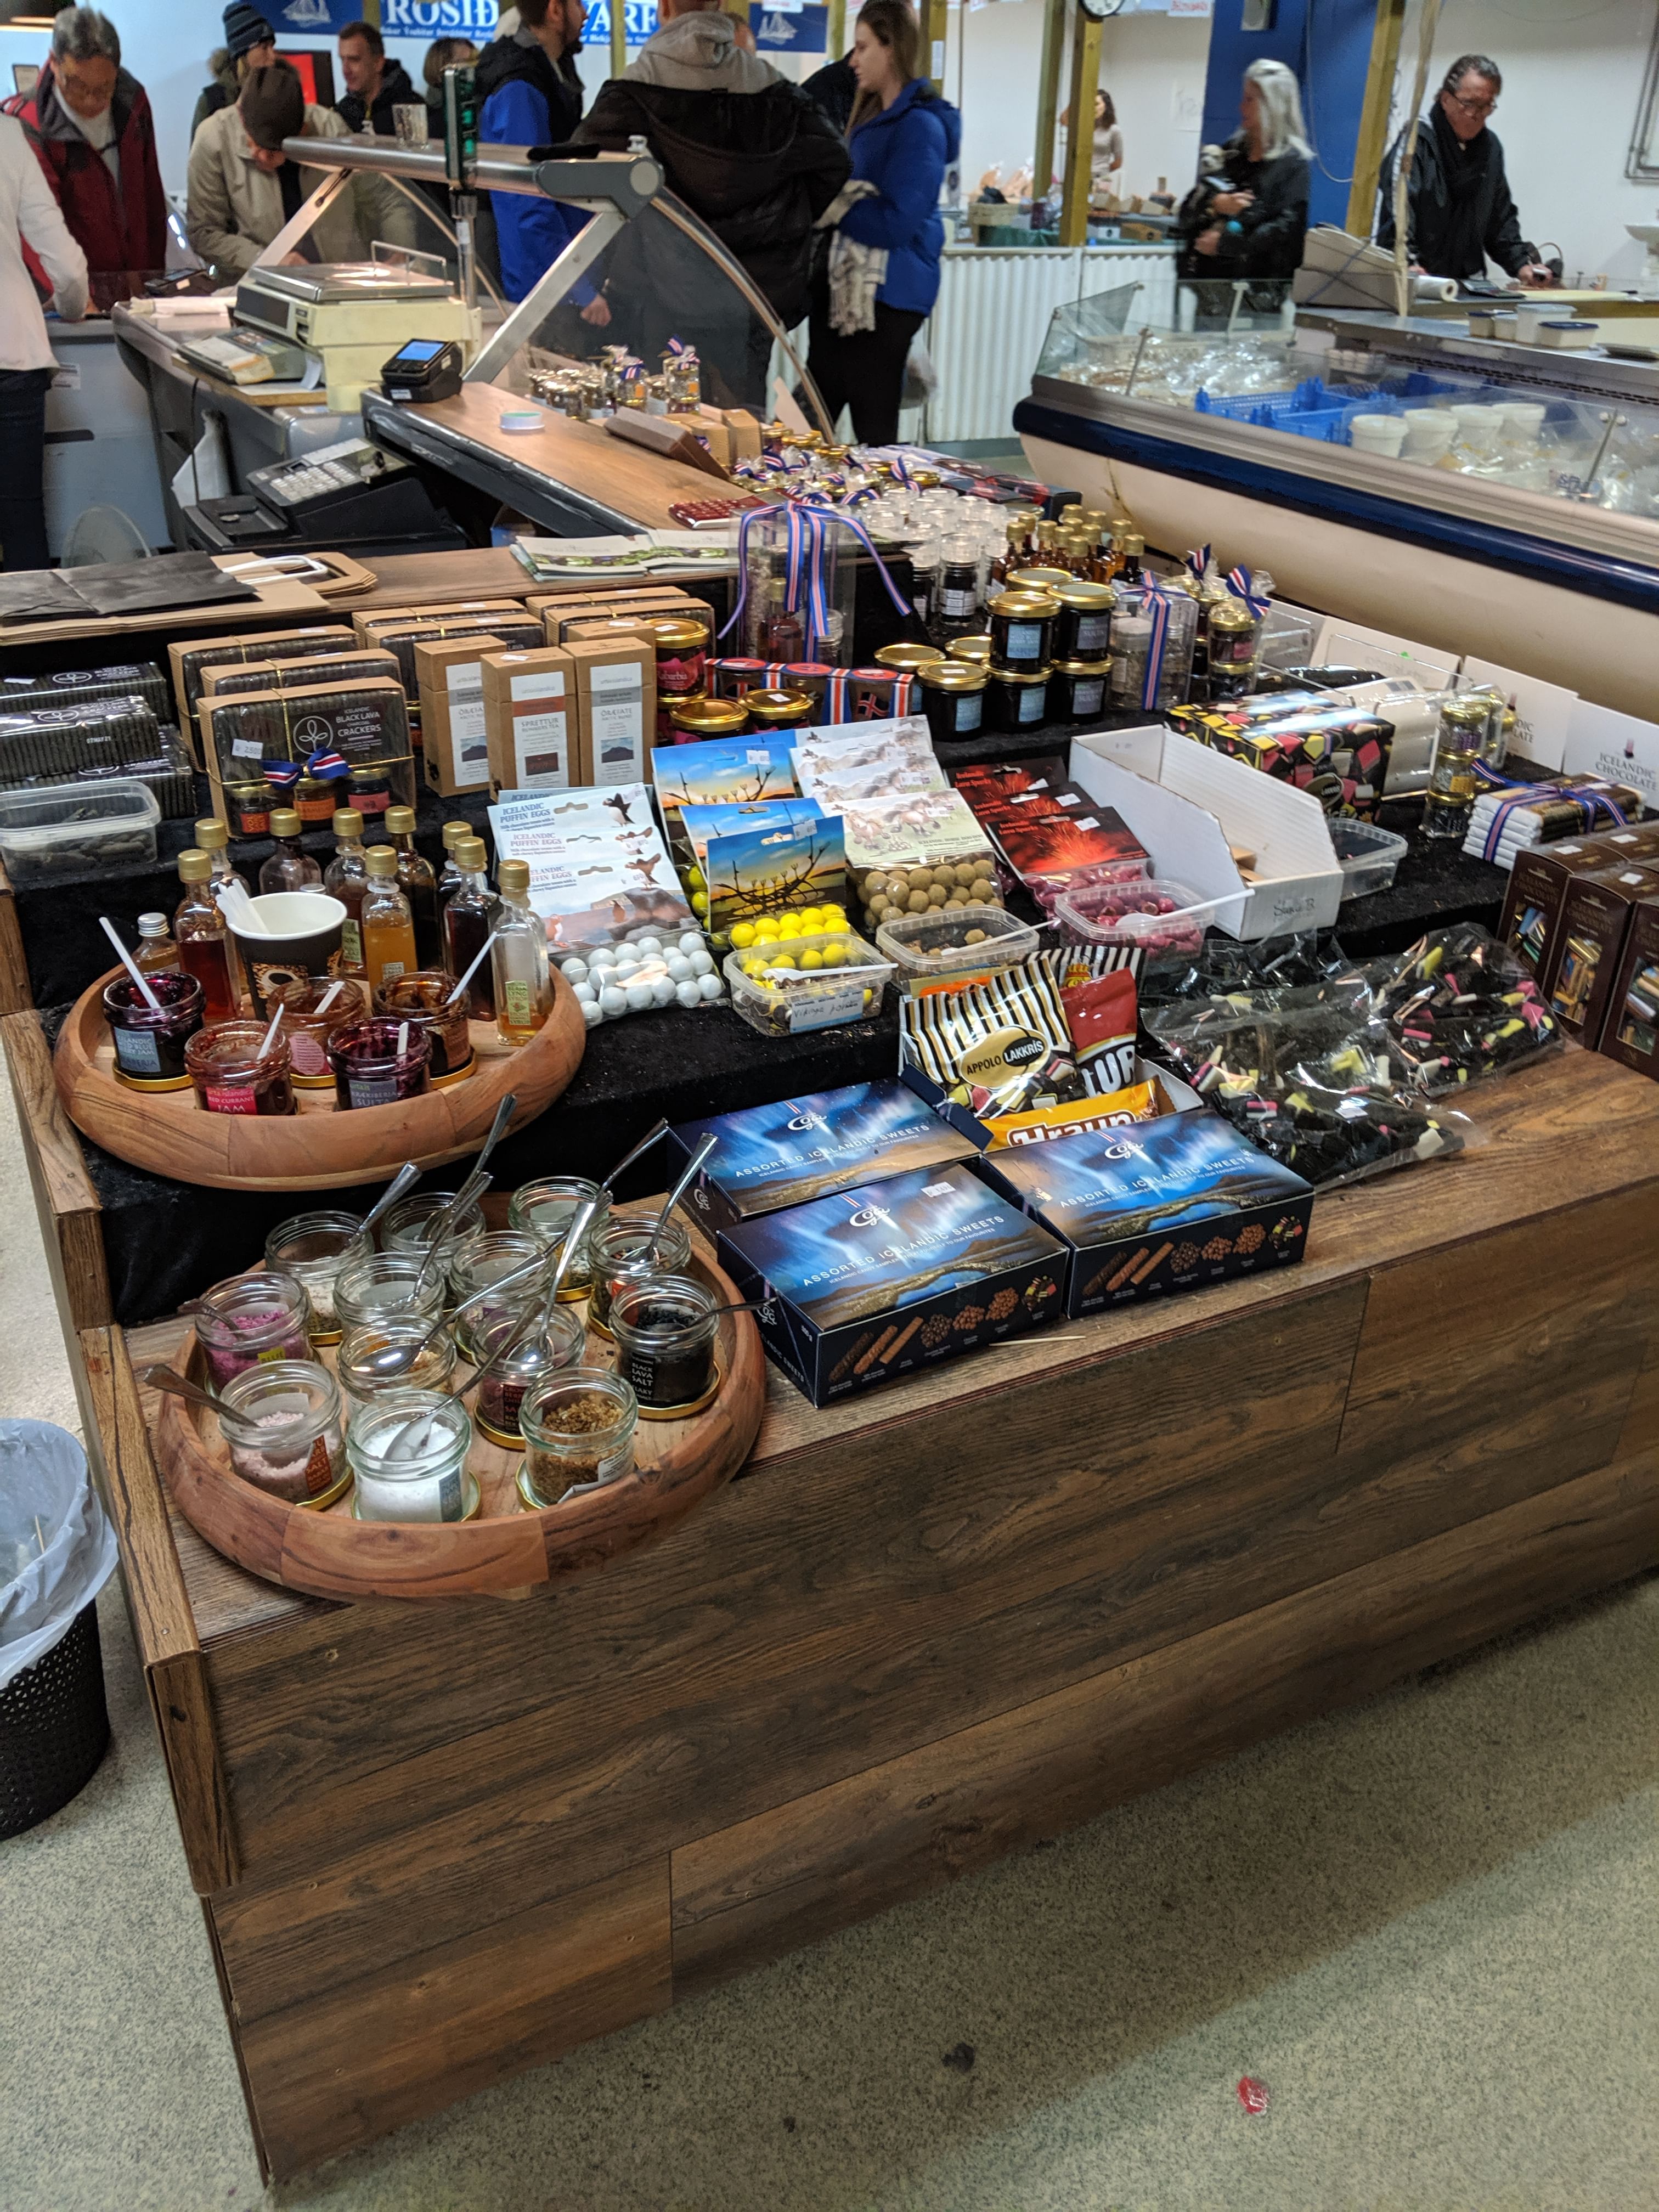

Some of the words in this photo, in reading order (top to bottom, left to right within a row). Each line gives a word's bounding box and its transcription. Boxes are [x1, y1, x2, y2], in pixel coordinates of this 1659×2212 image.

[336, 713, 359, 724] BLACK
[360, 712, 381, 720] LAVA
[522, 717, 559, 727] SPRETTUR
[337, 724, 382, 737] CRACKERS
[1600, 752, 1656, 779] ICELANDIC
[1595, 761, 1657, 791] CHOCOLATE
[503, 803, 544, 815] ICELANDIC
[974, 808, 990, 816] Lava
[500, 812, 528, 823] PUFFIN
[531, 809, 551, 818] EGGS
[530, 866, 565, 875] ELANDIC
[530, 873, 549, 883] FFIN
[551, 871, 572, 879] EGGS
[967, 1055, 1002, 1076] APPOLO
[1003, 1040, 1045, 1063] LAKKRÍS
[357, 1097, 390, 1106] SULTA
[218, 1104, 246, 1113] JAM
[735, 1155, 804, 1178] ASSORTED
[881, 1125, 930, 1141] SWEETS
[1060, 1183, 1129, 1209] ASSORTED
[1204, 1156, 1255, 1171] SWEETS
[803, 1256, 875, 1286] ASSORTED
[879, 1232, 950, 1259] ICELANDIC
[953, 1215, 1005, 1236] SWEETS
[829, 1271, 857, 1284] ICELANDIC
[631, 1362, 653, 1373] BLACK
[631, 1368, 653, 1379] LAVA
[783, 1357, 804, 1383] SWEETS
[631, 1375, 654, 1387] SALT
[306, 1459, 328, 1474] SALT
